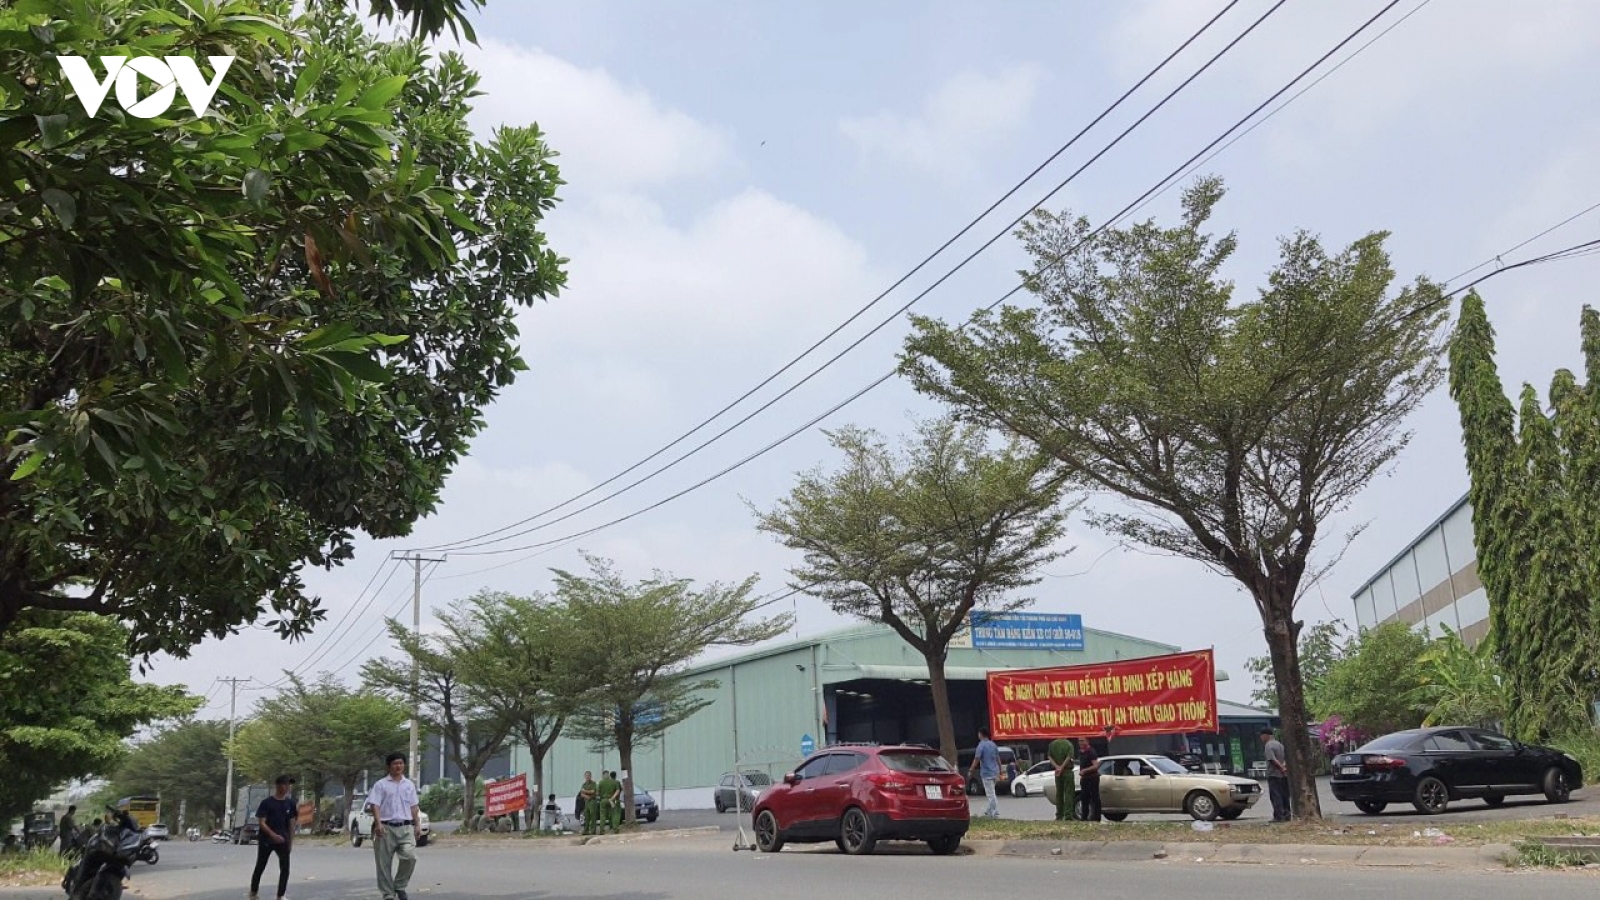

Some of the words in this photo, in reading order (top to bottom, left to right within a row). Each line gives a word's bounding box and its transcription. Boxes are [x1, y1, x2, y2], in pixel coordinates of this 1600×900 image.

[1015, 683, 1034, 703] NGHỊ
[1034, 676, 1050, 699] CHỦ
[1051, 680, 1064, 698] XE
[1064, 679, 1078, 697] KHI
[1079, 671, 1097, 696] ĐẾN
[1098, 667, 1121, 695] KIỂM
[1122, 674, 1144, 697] ĐỊNH
[1145, 664, 1165, 691] XẾP
[1165, 665, 1193, 690] HÀNG
[997, 709, 1016, 732] TRẬT
[1017, 709, 1027, 732] TỰ
[1027, 707, 1040, 729] VÀ
[1040, 704, 1058, 728] ĐẢM
[1059, 703, 1076, 727] BẢO
[1077, 704, 1099, 730] TRẬT
[1114, 706, 1127, 725] AN
[1127, 700, 1152, 724] TOÀN
[1153, 703, 1176, 722] GIAO
[1175, 696, 1207, 721] THÔNG
